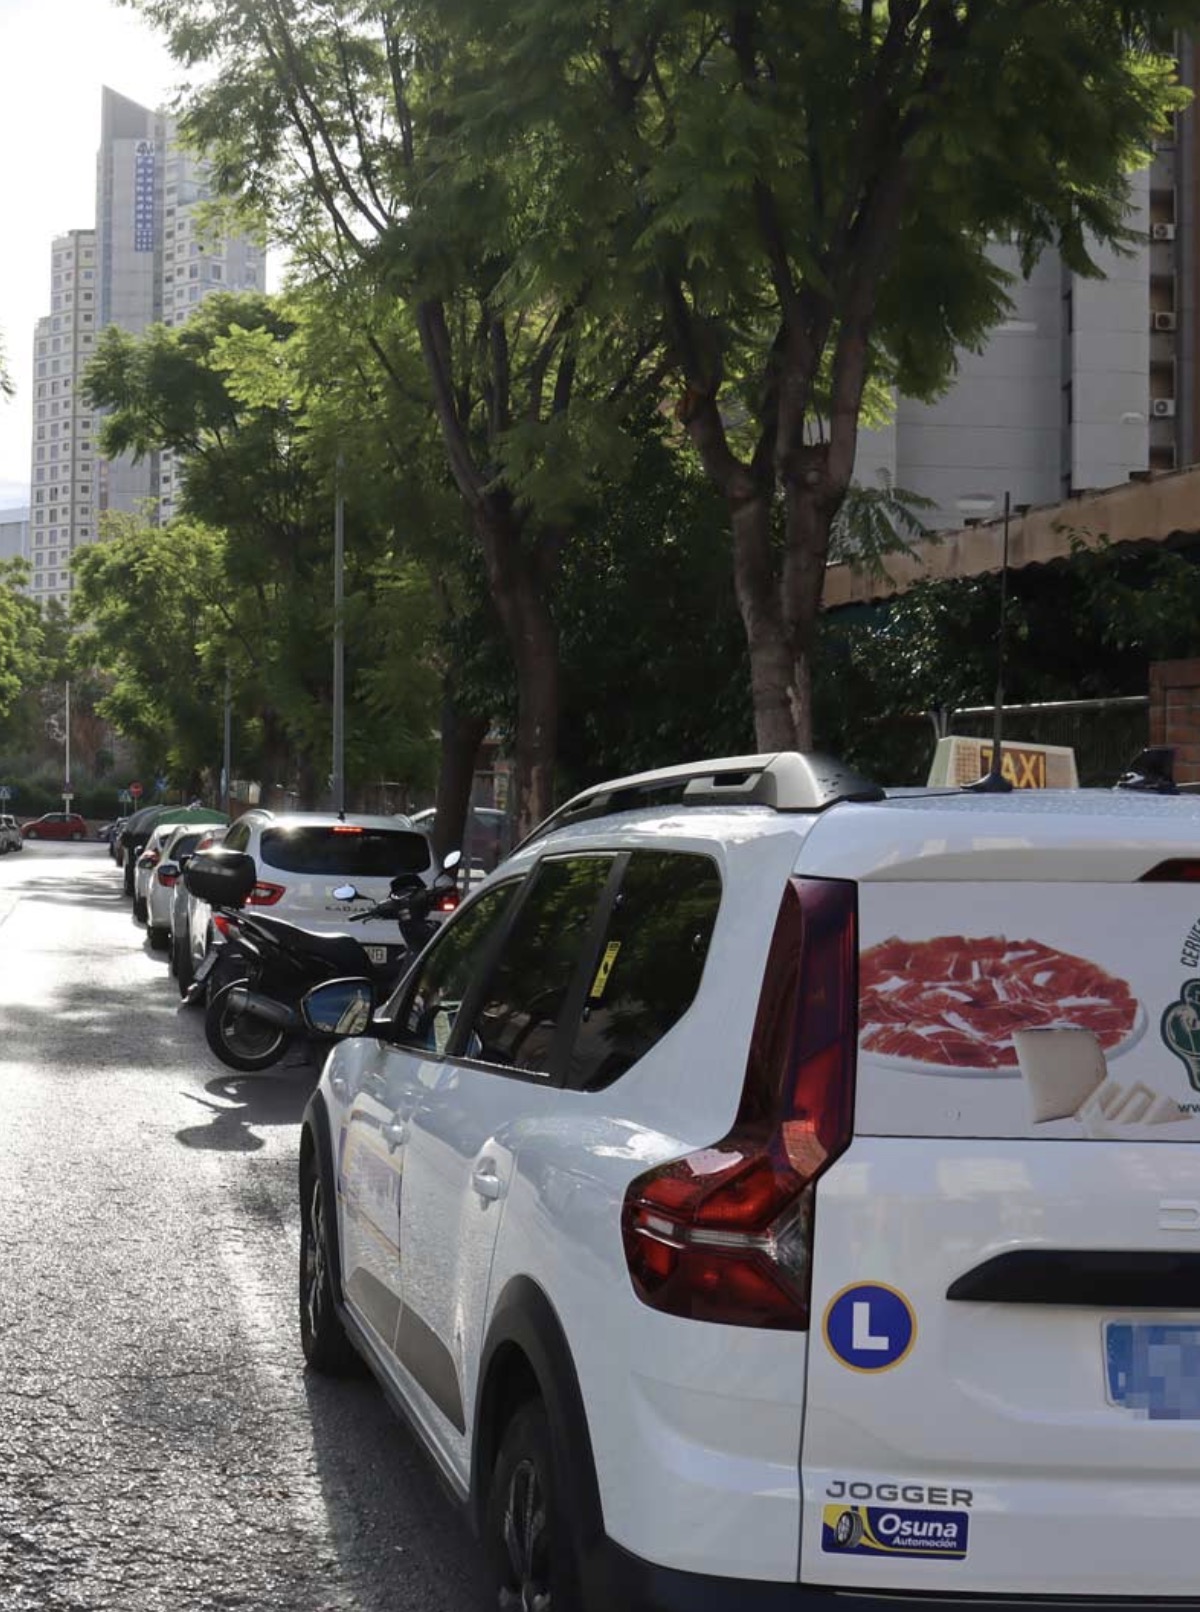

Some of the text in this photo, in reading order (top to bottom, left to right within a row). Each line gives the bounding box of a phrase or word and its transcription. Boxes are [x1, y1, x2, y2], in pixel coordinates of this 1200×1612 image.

[852, 1301, 889, 1351] L
[825, 1479, 974, 1508] JOGGER
[877, 1513, 959, 1538] Osuna
[892, 1536, 957, 1548] Automoción
